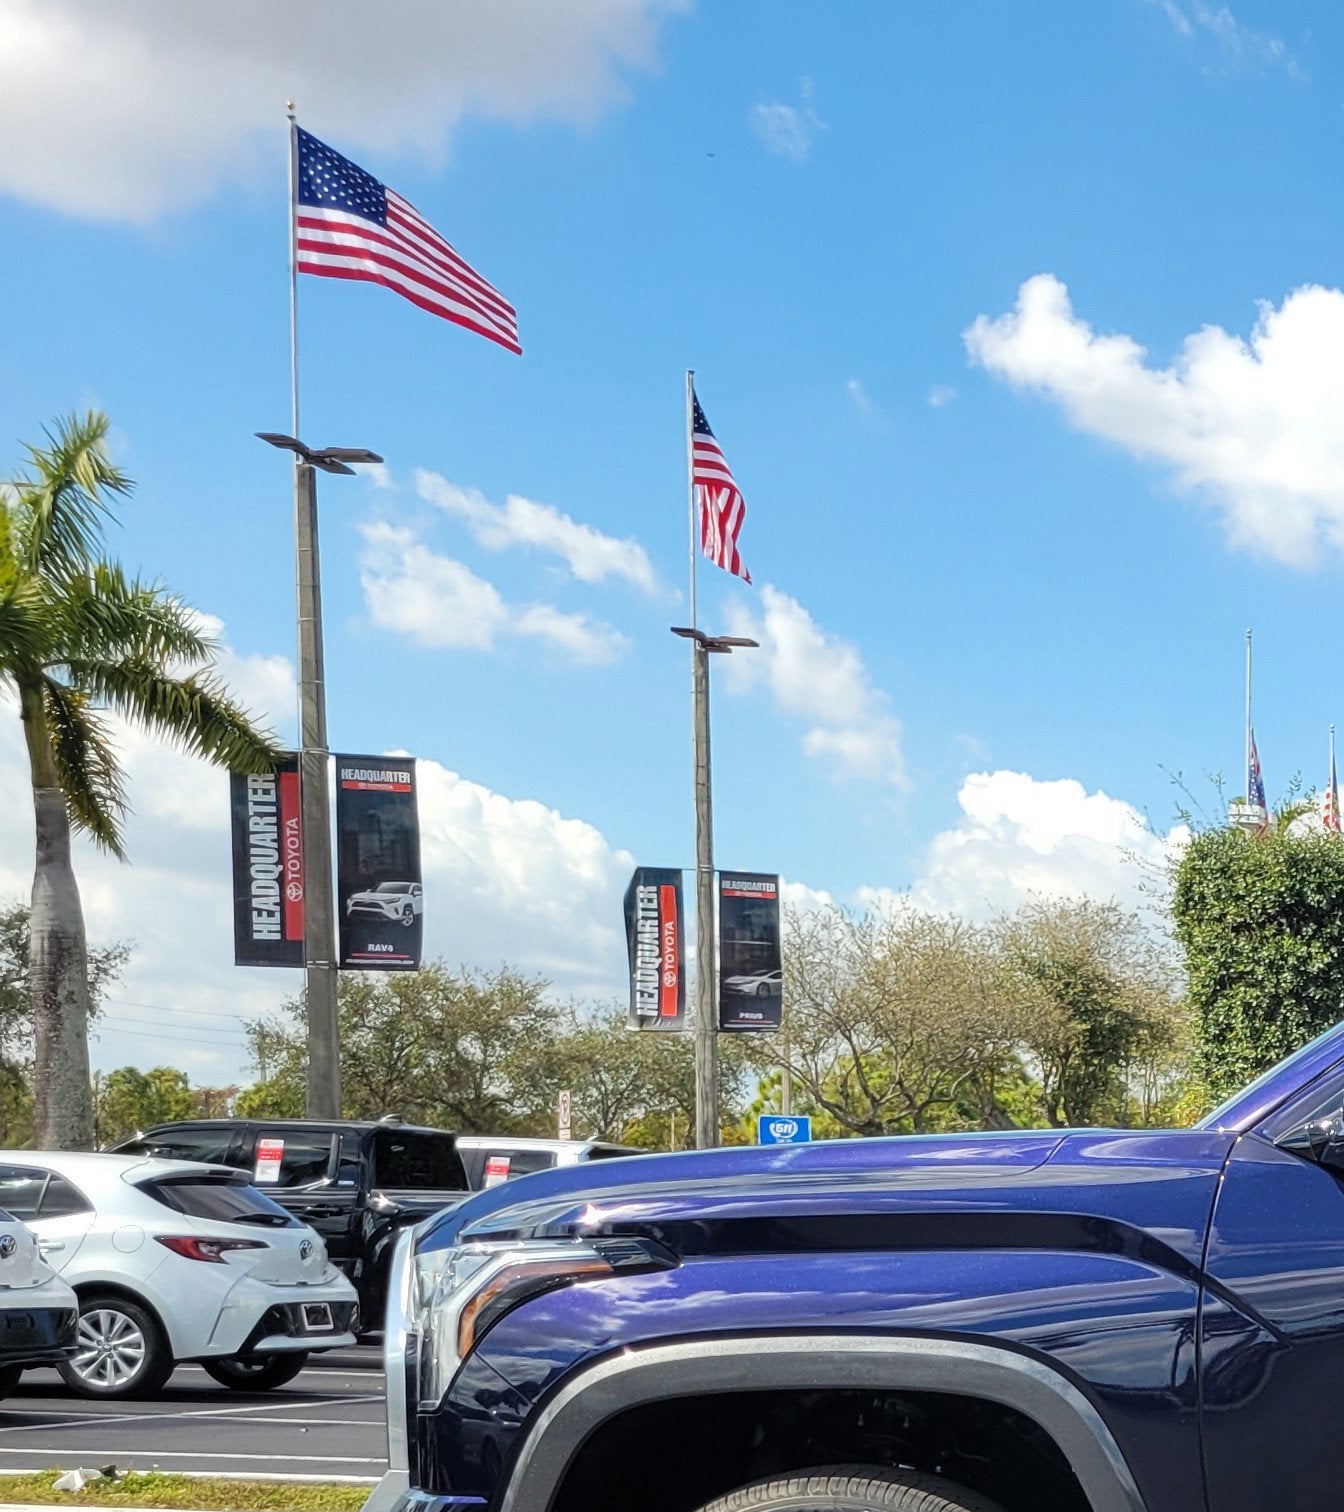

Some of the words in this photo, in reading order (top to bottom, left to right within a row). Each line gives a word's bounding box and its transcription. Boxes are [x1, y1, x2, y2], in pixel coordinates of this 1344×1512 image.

[341, 768, 411, 784] HEADQUARTER
[248, 772, 283, 940] HEADQUARTER
[287, 817, 301, 880] TOYOTA
[368, 943, 394, 953] RAV4
[636, 885, 662, 1017] HEADQUARTER
[664, 921, 676, 971] TOYOTA
